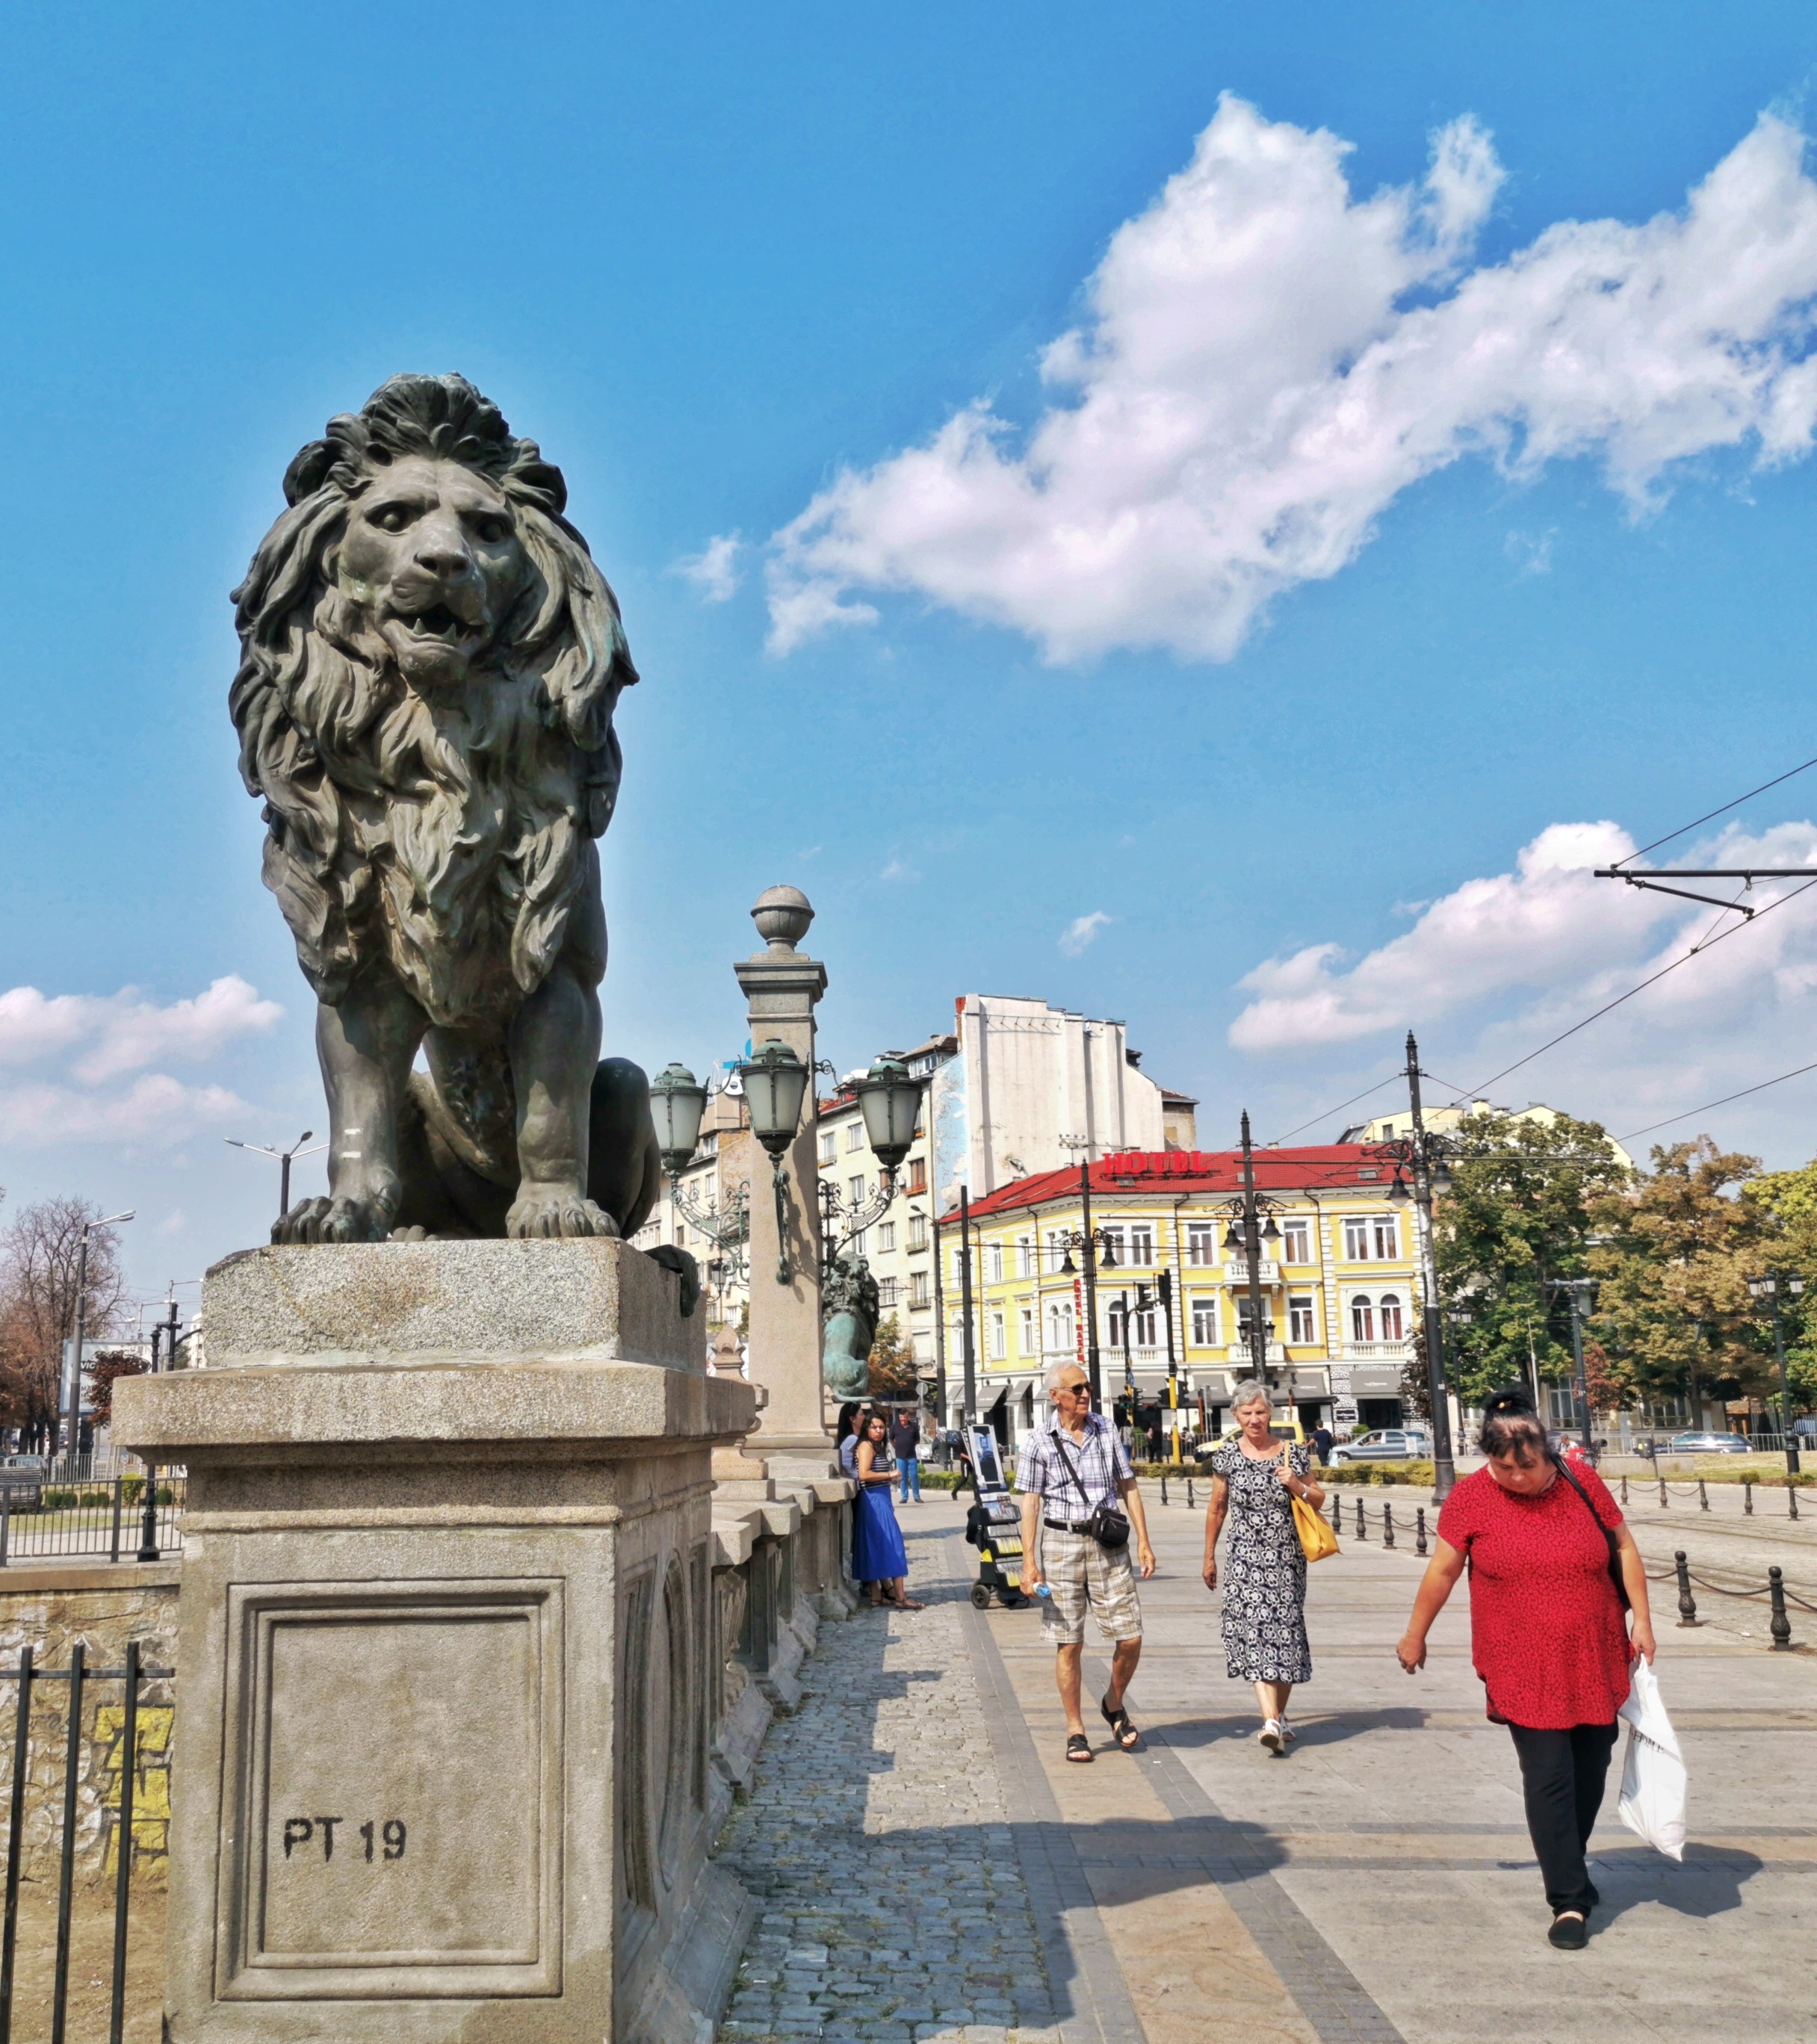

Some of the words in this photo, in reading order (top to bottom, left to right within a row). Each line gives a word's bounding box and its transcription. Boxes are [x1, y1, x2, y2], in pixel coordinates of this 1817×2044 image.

[1103, 1150, 1208, 1174] HOTEL
[284, 1816, 344, 1863] PT
[359, 1819, 406, 1864] 19
